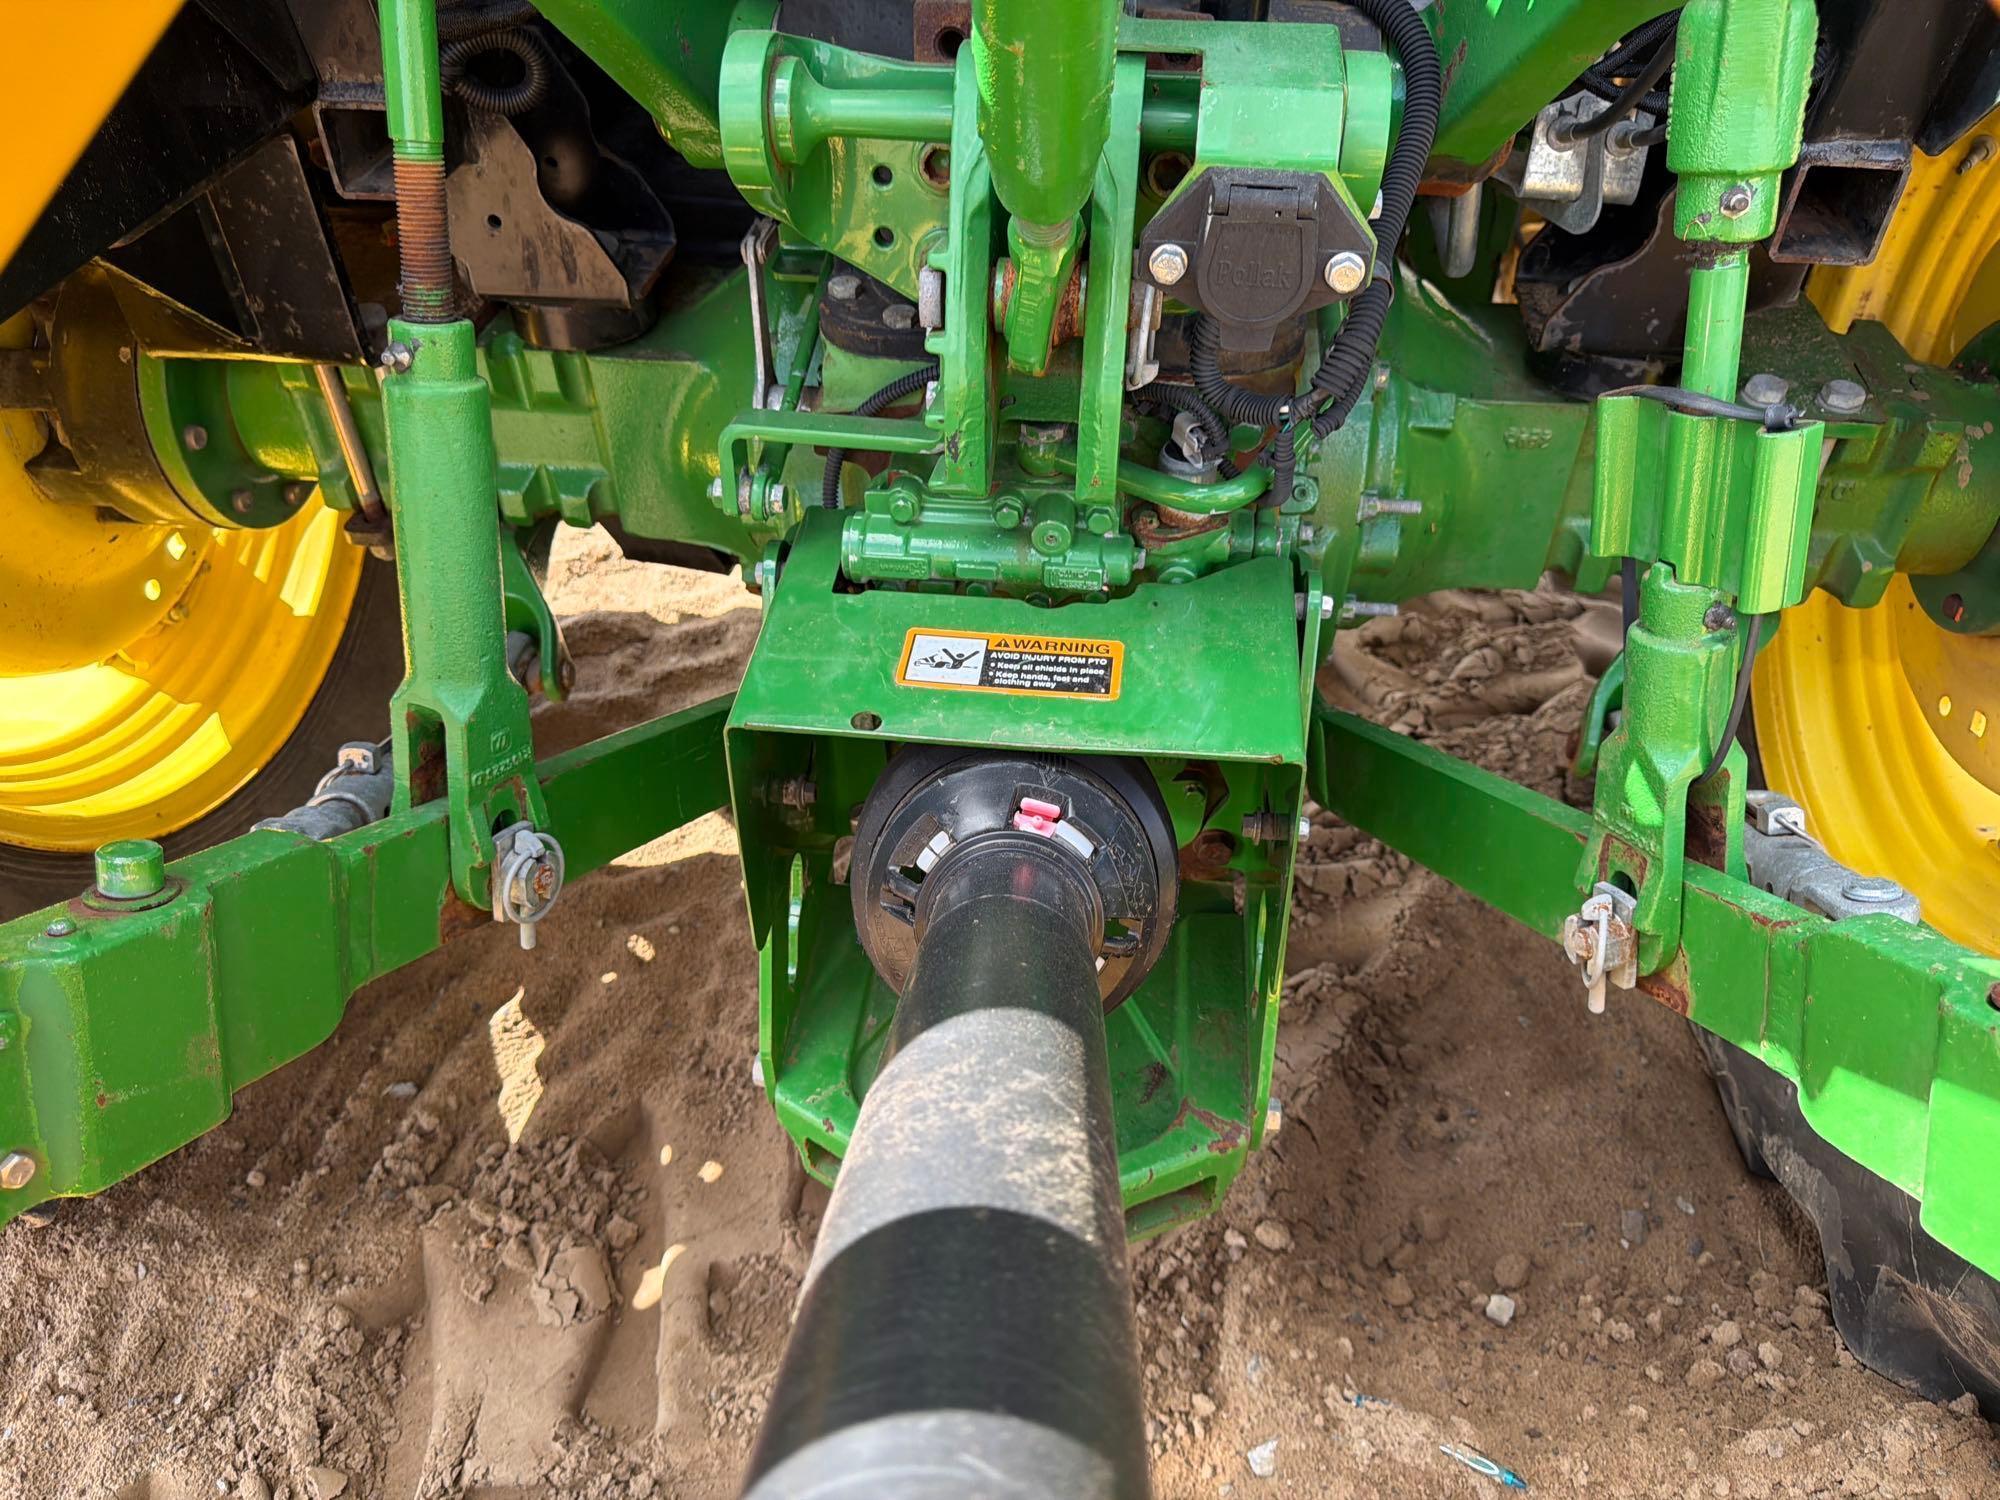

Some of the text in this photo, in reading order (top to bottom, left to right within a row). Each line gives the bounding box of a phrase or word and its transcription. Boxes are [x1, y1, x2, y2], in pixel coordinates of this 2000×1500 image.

[1216, 260, 1294, 288] Pollak
[1013, 639, 1110, 654] WARNING
[990, 652, 1108, 665] AVOID INJURY FROM PTO
[997, 662, 1020, 671] Keep
[995, 671, 1018, 679] Keep
[994, 678, 1056, 689] clothing away
